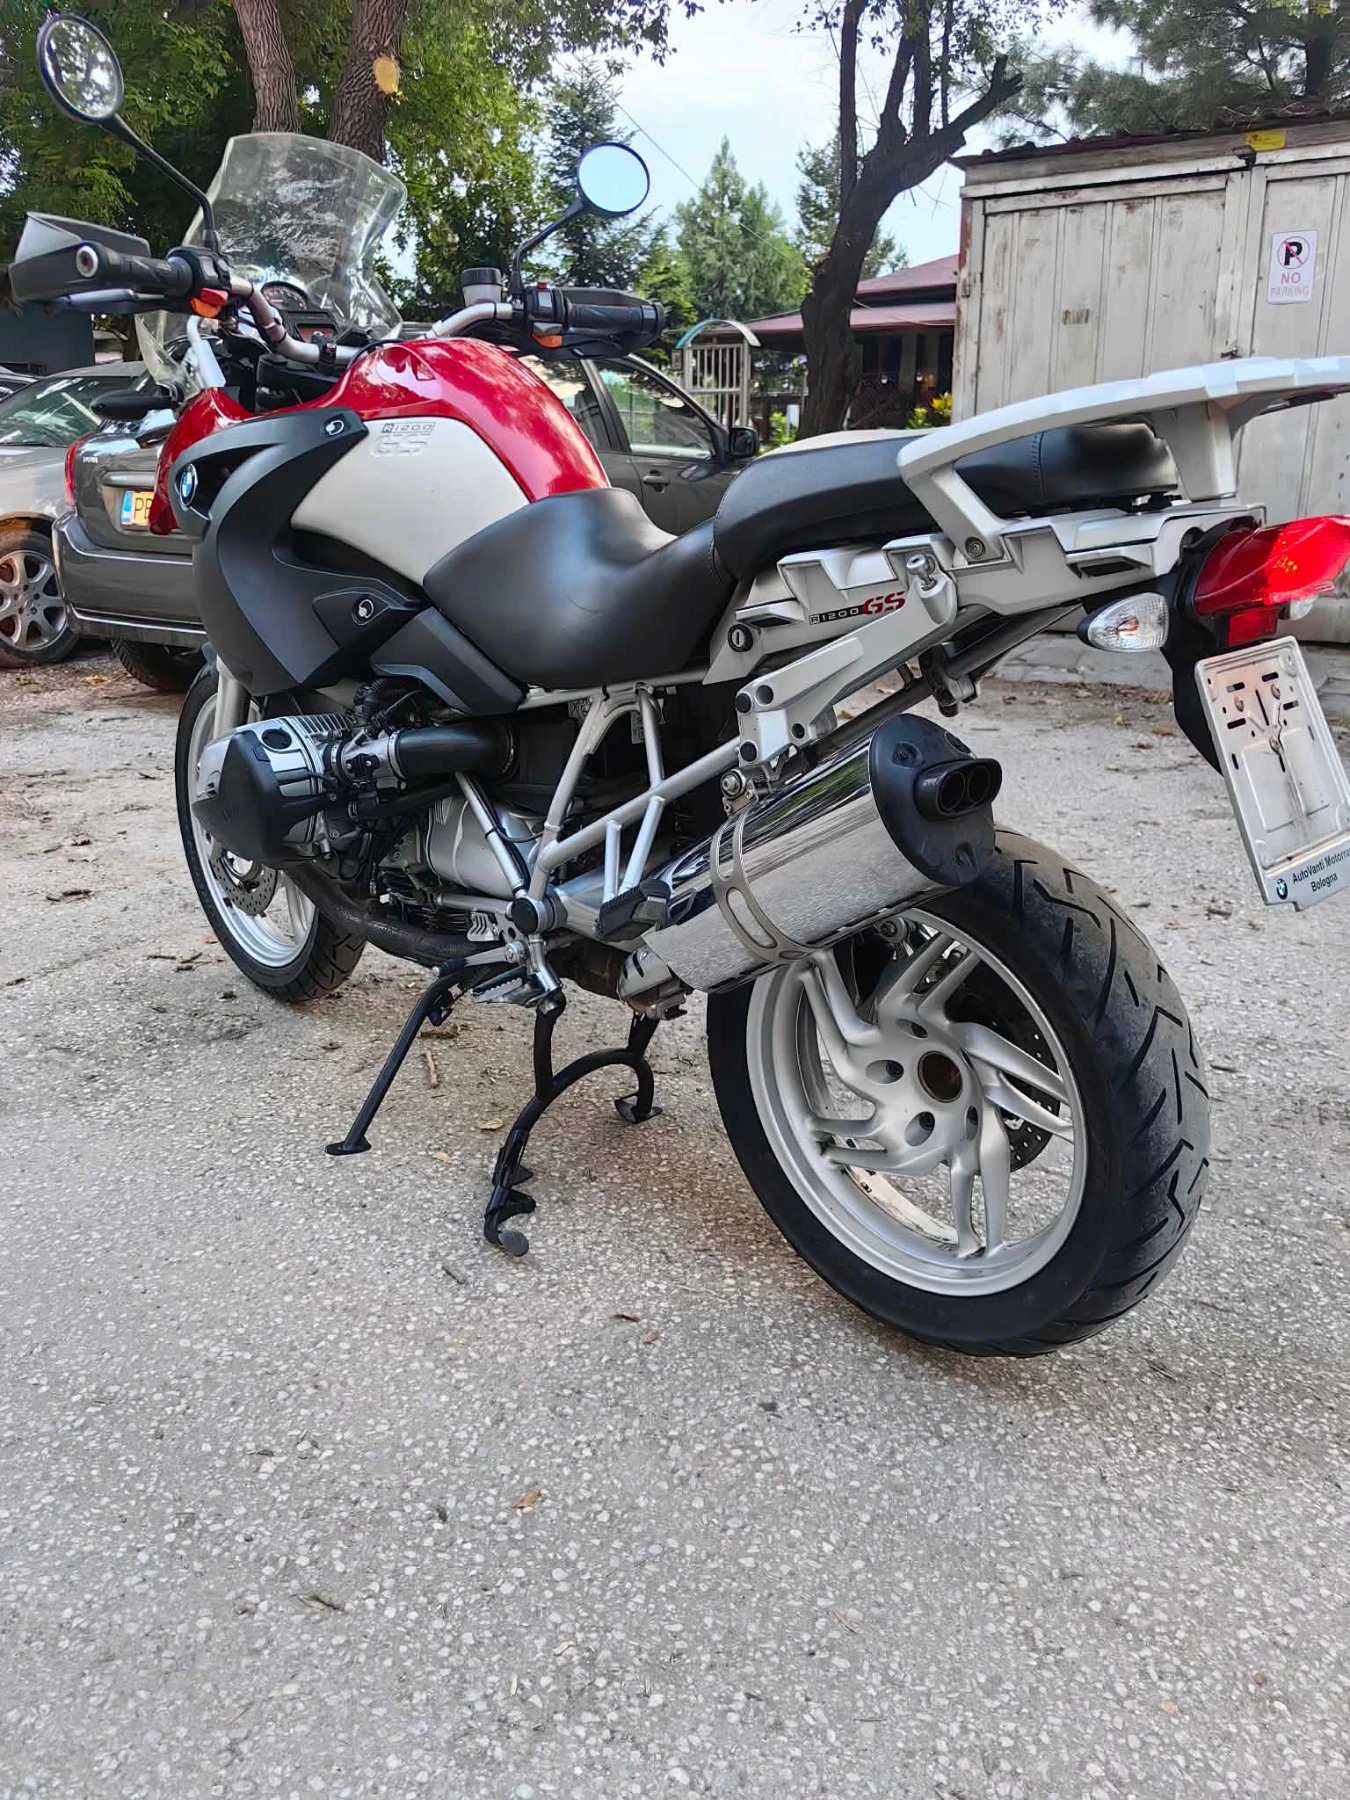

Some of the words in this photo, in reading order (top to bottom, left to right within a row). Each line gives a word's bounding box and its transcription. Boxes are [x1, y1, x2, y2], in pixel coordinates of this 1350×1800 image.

[1284, 241, 1303, 266] P
[1280, 272, 1301, 284] NO
[1271, 286, 1309, 297] PARKING
[381, 422, 436, 433] R1200
[810, 607, 860, 625] R1200
[862, 590, 906, 616] GS
[1292, 859, 1325, 884] AutoVanti
[1311, 873, 1338, 892] Bologna
